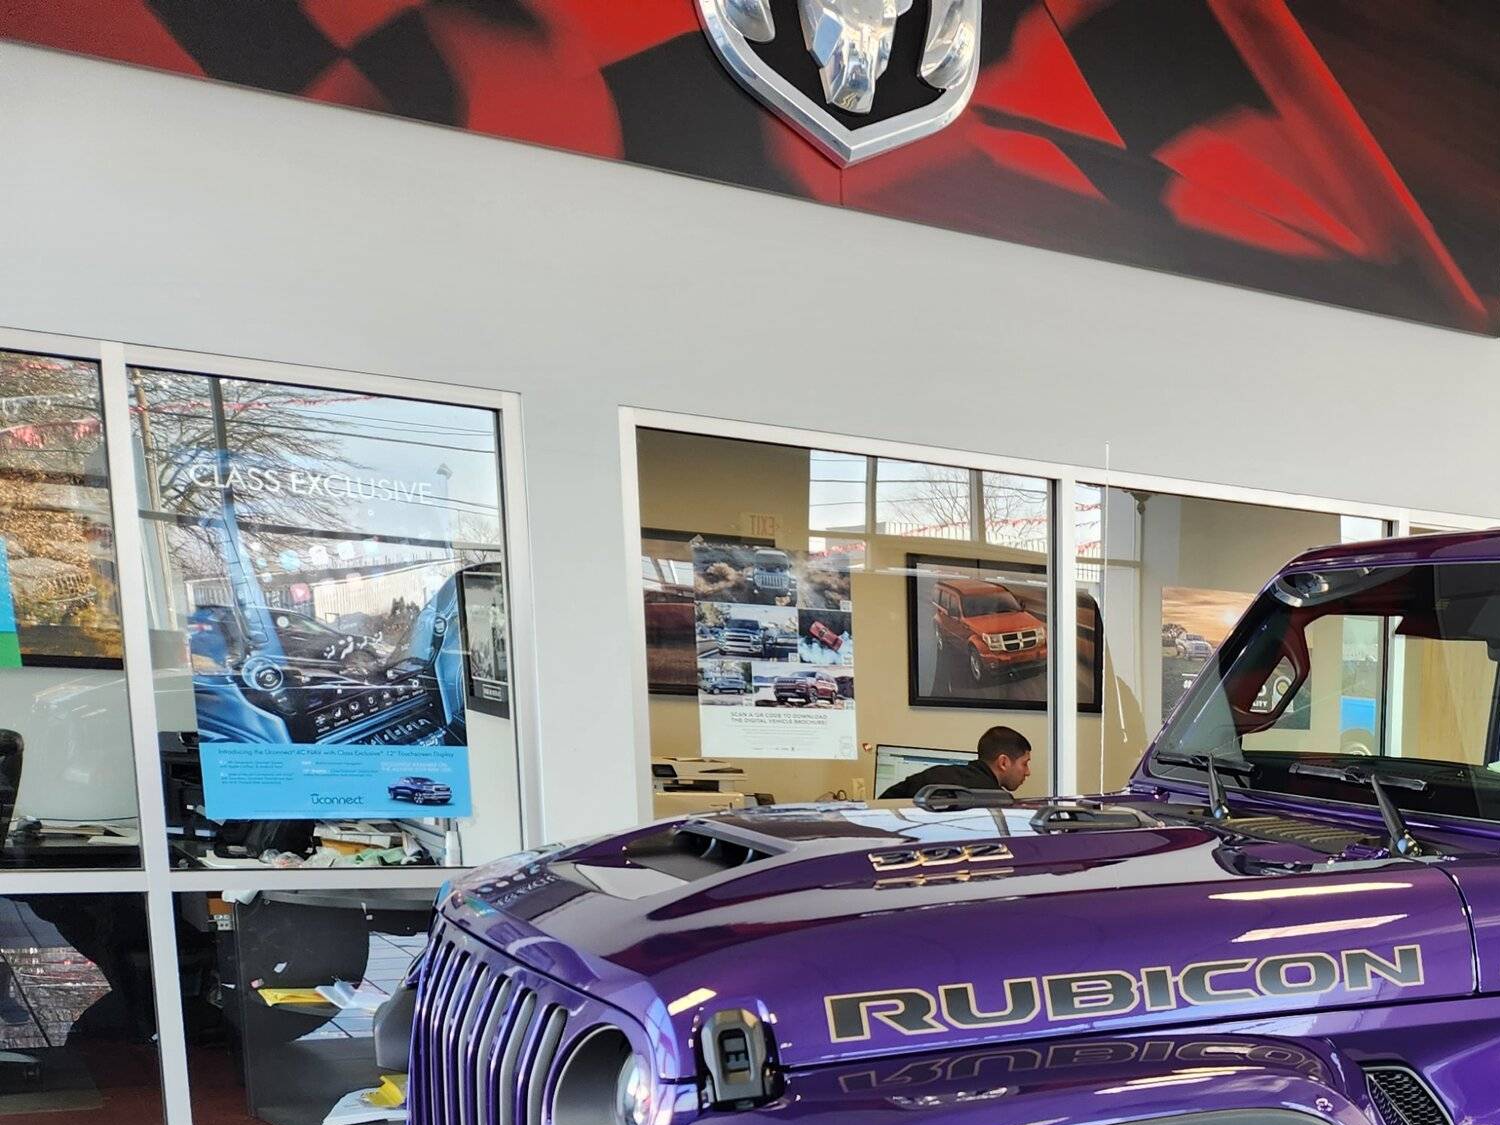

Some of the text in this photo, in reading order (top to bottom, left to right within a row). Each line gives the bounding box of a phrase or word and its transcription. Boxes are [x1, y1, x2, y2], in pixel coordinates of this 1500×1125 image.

[189, 463, 433, 505] CLASS EXCLUSIVE
[824, 943, 1426, 1044] RUBICON
